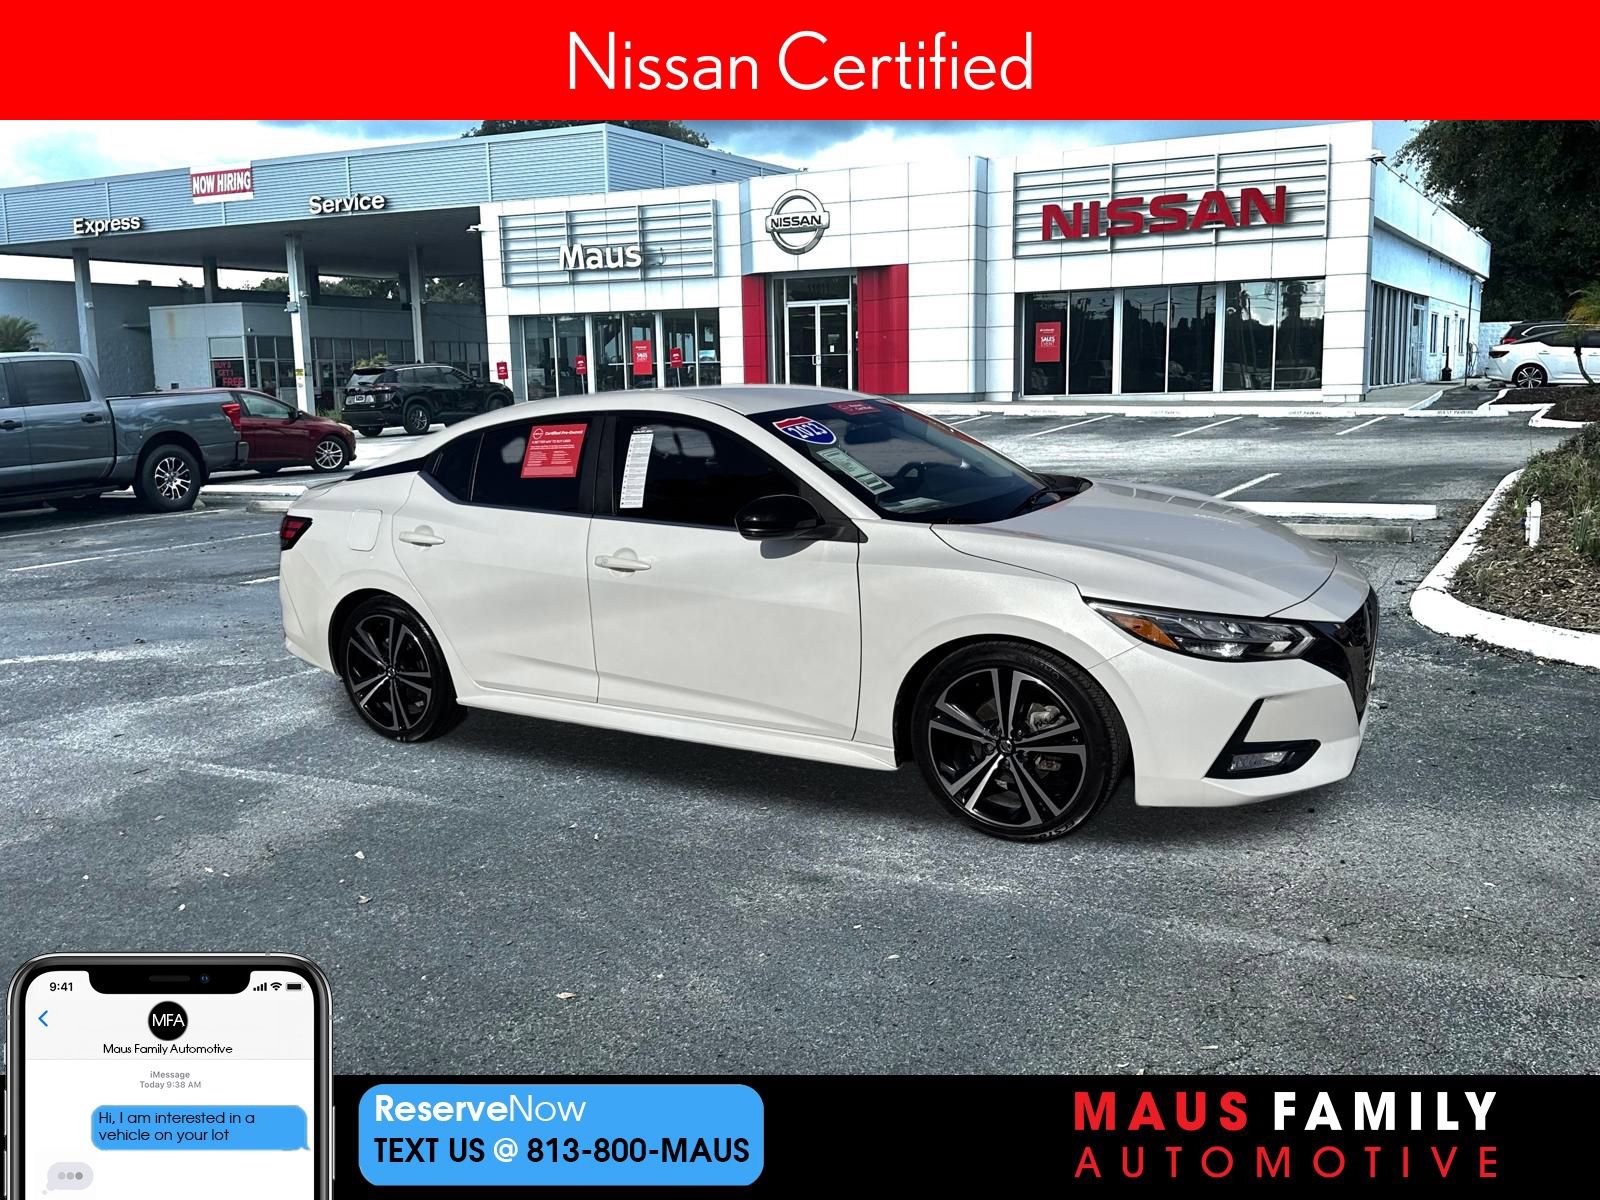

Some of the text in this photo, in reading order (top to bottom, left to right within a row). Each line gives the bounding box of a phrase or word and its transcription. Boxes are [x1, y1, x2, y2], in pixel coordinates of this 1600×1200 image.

[192, 170, 252, 195] NOW HIRING
[309, 194, 385, 215] Service
[1042, 185, 1287, 241] NISSAN
[73, 215, 141, 237] Express
[770, 215, 822, 228] NISSAN
[559, 244, 642, 270] Maus
[223, 377, 244, 387] FREE
[787, 423, 828, 438] 2023
